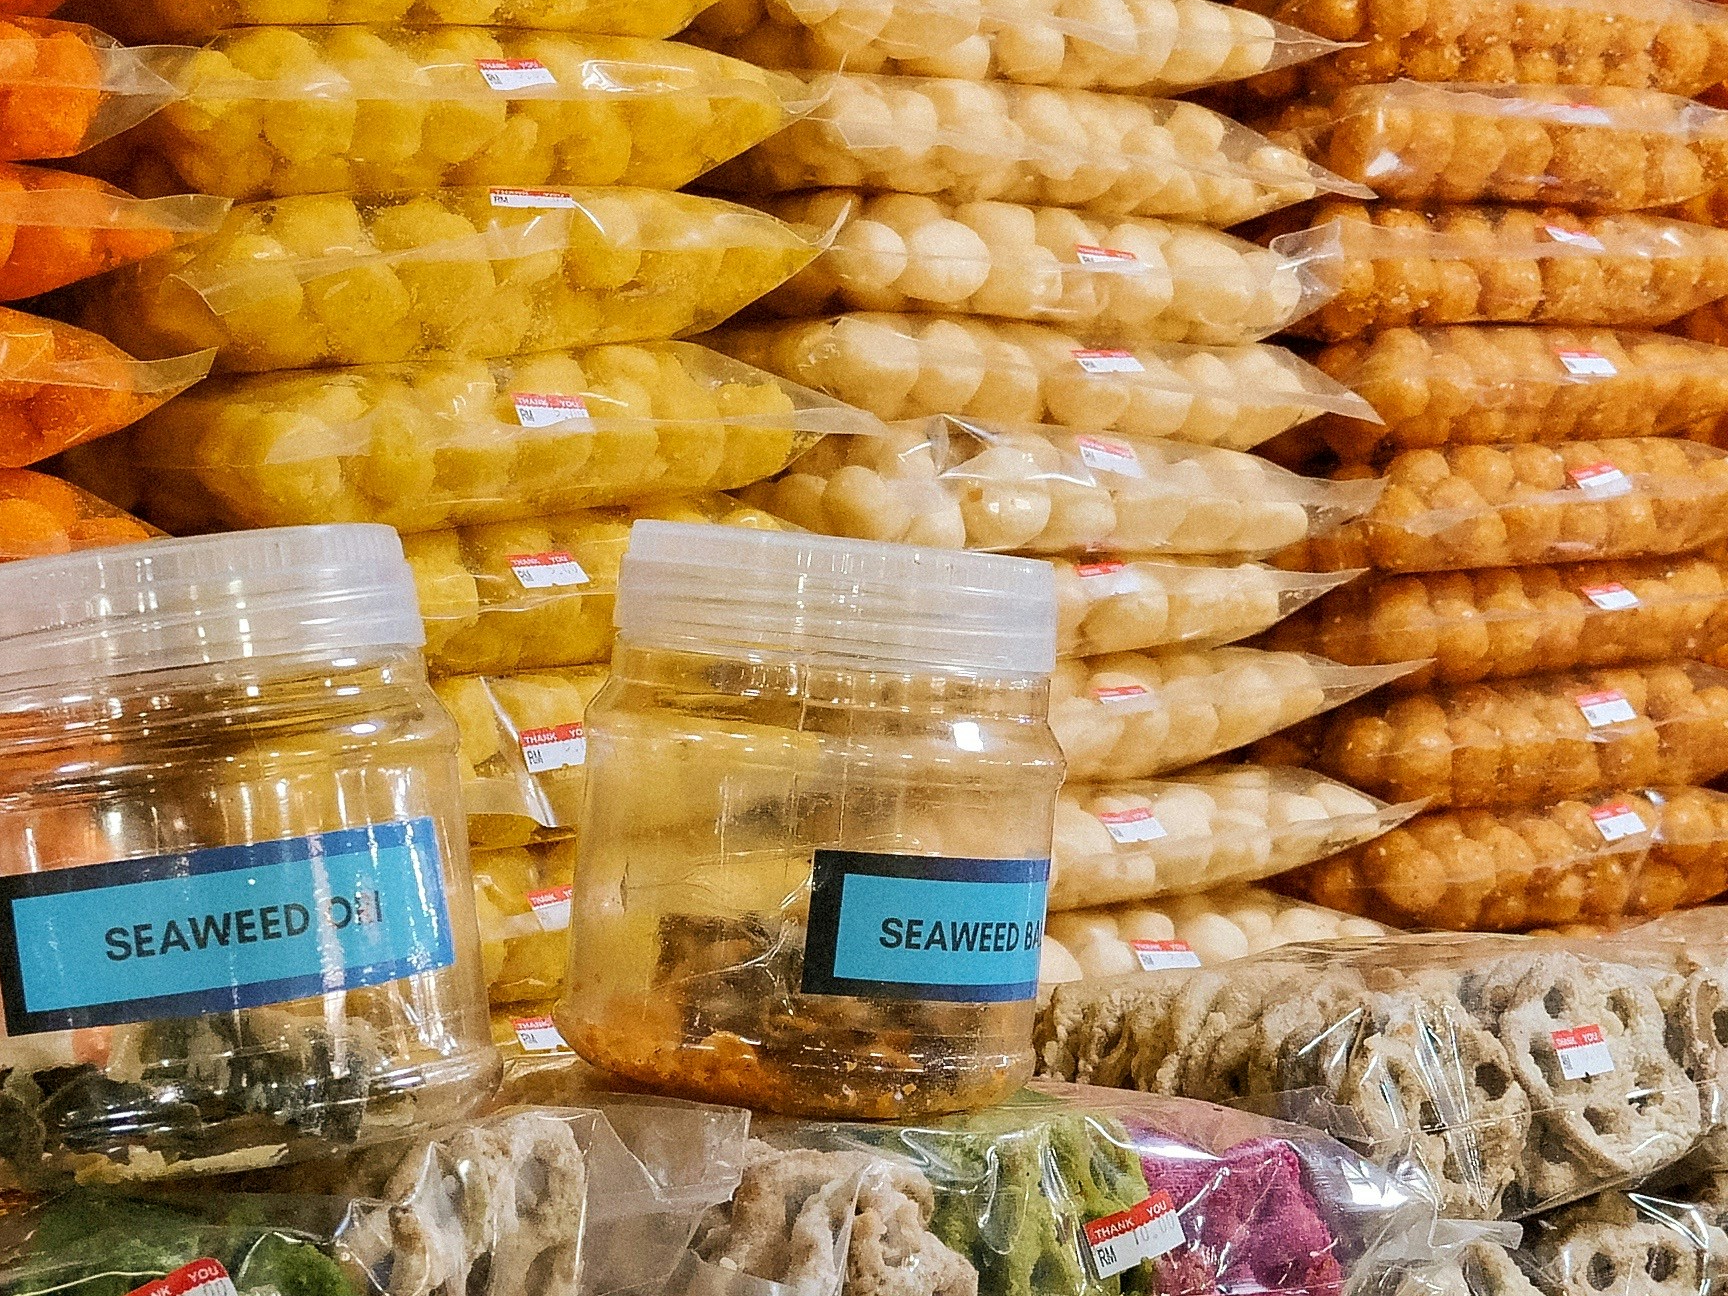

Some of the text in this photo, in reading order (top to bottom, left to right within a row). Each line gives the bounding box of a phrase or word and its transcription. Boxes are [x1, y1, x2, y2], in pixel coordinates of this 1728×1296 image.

[522, 728, 583, 744] THANK YO
[526, 748, 544, 765] RM
[104, 901, 311, 961] SEAWEED
[878, 917, 1020, 952] SEAWEED
[1093, 1199, 1167, 1241] THANK YOU
[1097, 1246, 1118, 1268] RM
[189, 1263, 220, 1283] YOU
